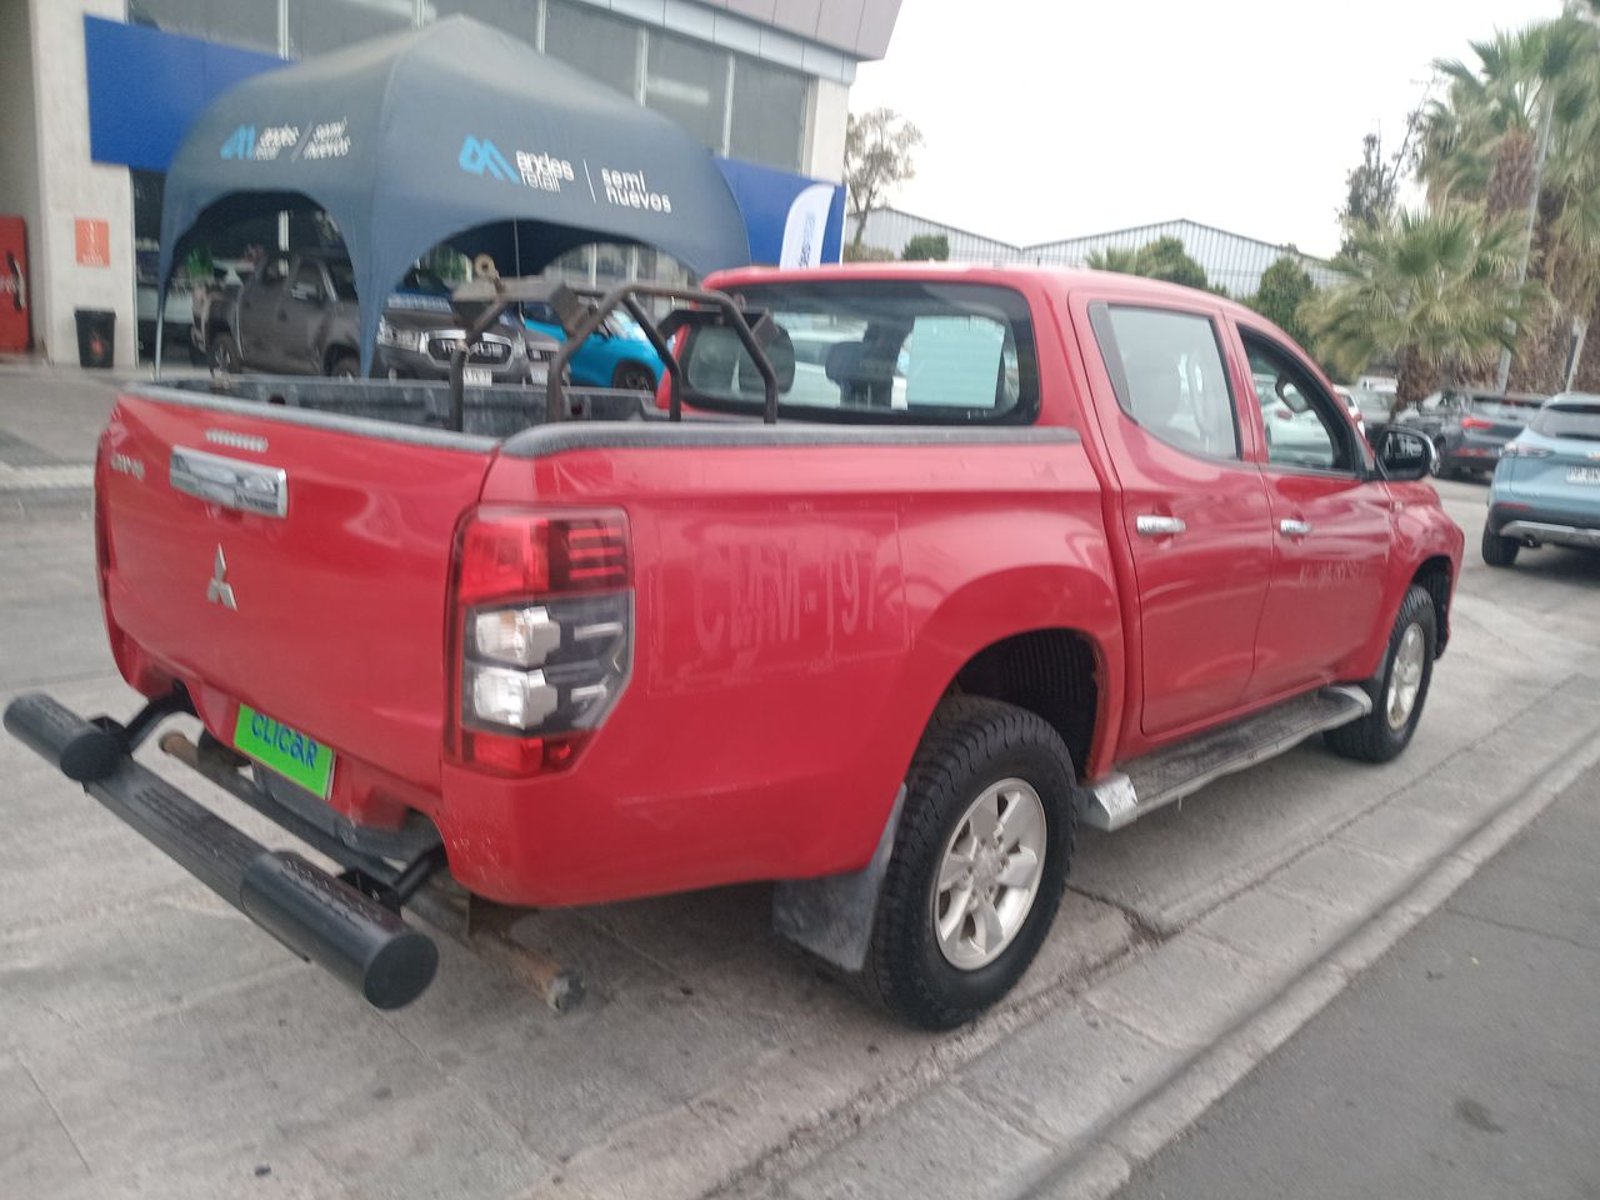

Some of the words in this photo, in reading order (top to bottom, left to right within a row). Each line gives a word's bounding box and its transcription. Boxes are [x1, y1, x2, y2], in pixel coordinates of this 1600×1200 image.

[515, 150, 574, 181] andes
[520, 170, 560, 193] retail
[601, 167, 646, 192] semi
[605, 186, 672, 213] nuevos
